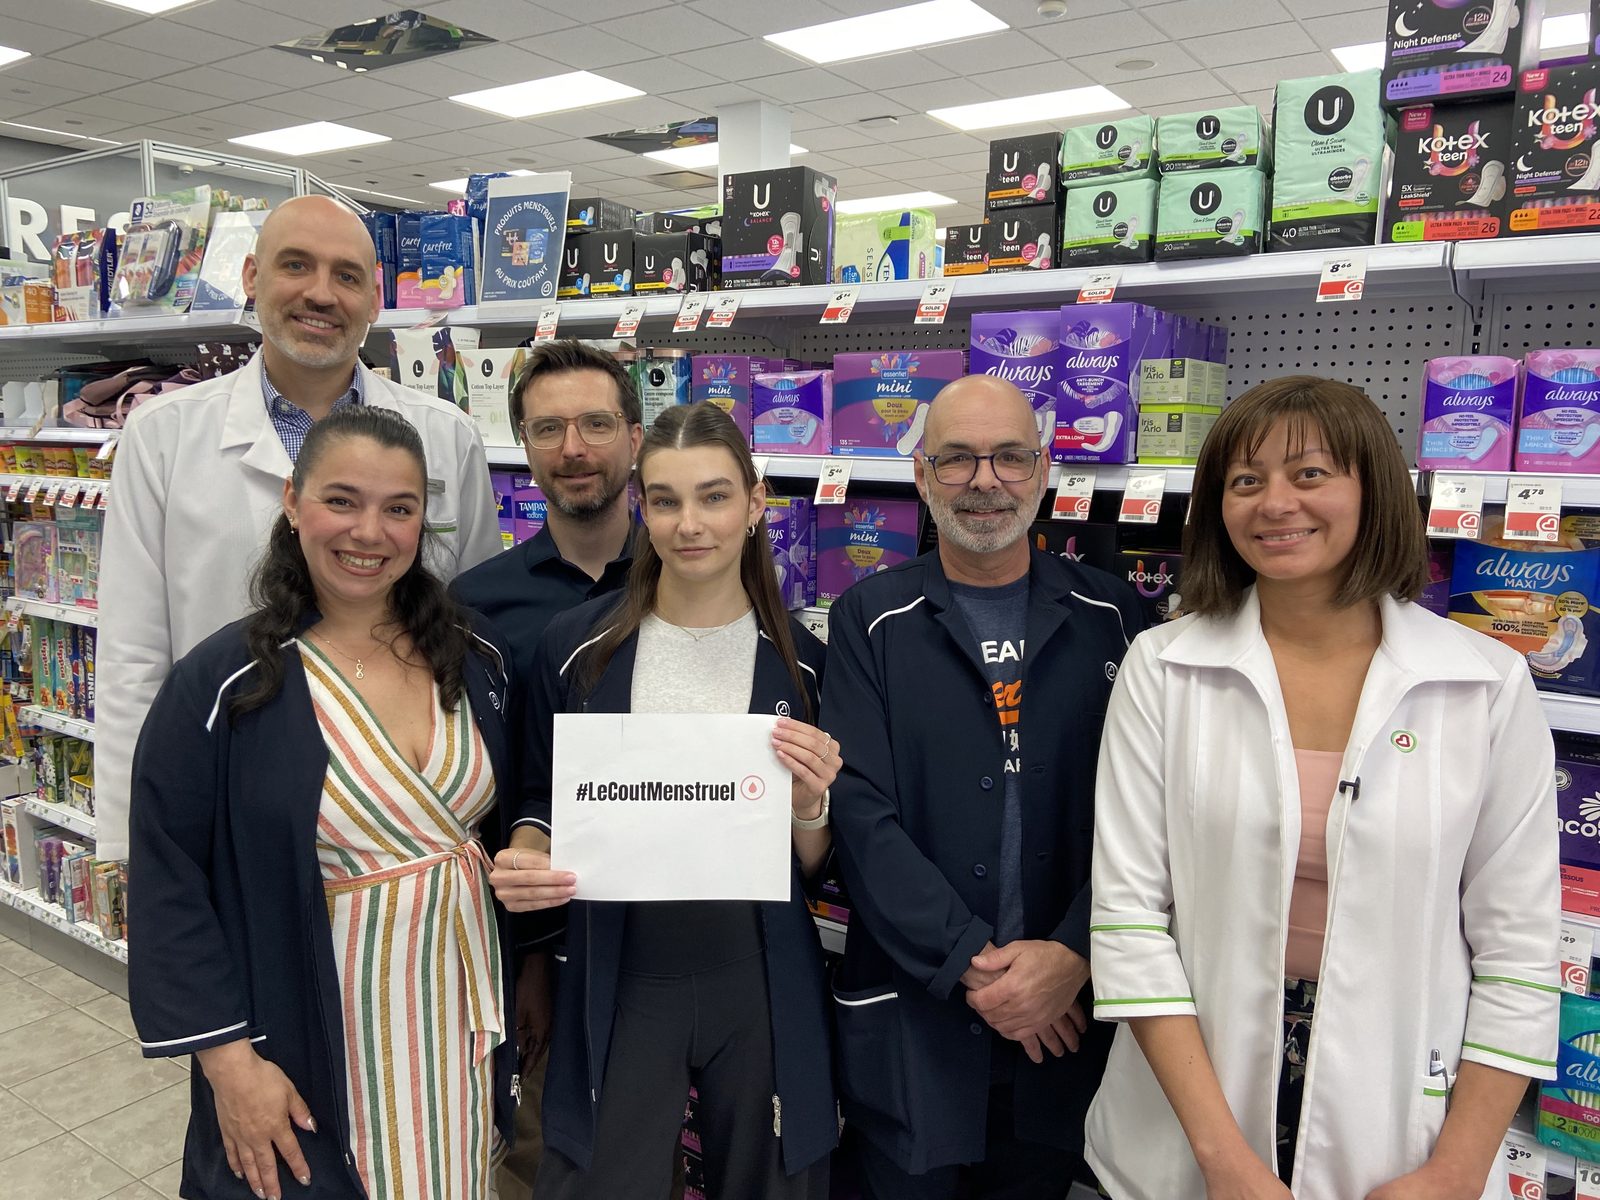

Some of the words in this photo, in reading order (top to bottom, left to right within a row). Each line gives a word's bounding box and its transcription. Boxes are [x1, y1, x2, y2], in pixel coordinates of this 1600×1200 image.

[1393, 37, 1418, 49] Night
[1492, 71, 1507, 82] 24
[1318, 96, 1340, 126] U
[1202, 120, 1214, 136] U
[1550, 122, 1583, 134] teen
[1102, 130, 1112, 144] U
[1004, 152, 1018, 172] U
[1438, 151, 1468, 162] teen
[754, 182, 770, 210] U
[1198, 190, 1213, 210] U
[1099, 197, 1111, 212] U
[494, 203, 522, 236] PRODUITS
[524, 200, 558, 233] MENSTRUELS
[1004, 221, 1018, 240] U
[1282, 228, 1296, 238] 40
[1481, 222, 1496, 233] 26
[970, 227, 982, 244] U
[422, 240, 452, 254] Carefree
[604, 242, 616, 264] U
[567, 248, 578, 268] U
[646, 256, 654, 270] U
[494, 267, 504, 279] AU
[502, 276, 518, 288] PRIX
[1066, 351, 1120, 374] always
[1144, 364, 1156, 373] Iris
[708, 386, 732, 394] mini
[876, 380, 912, 392] mini
[773, 392, 800, 406] always
[1443, 392, 1494, 410] always
[1545, 386, 1600, 406] always
[768, 528, 784, 543] ays
[850, 531, 879, 542] mini
[1476, 552, 1574, 589] always
[1504, 578, 1536, 589] MAXI
[1491, 622, 1520, 633] 100%
[576, 782, 736, 802] #LeCoutMenstruel
[1561, 874, 1584, 882] ESSOUS
[1560, 936, 1576, 944] 49
[1557, 1118, 1566, 1130] 2
